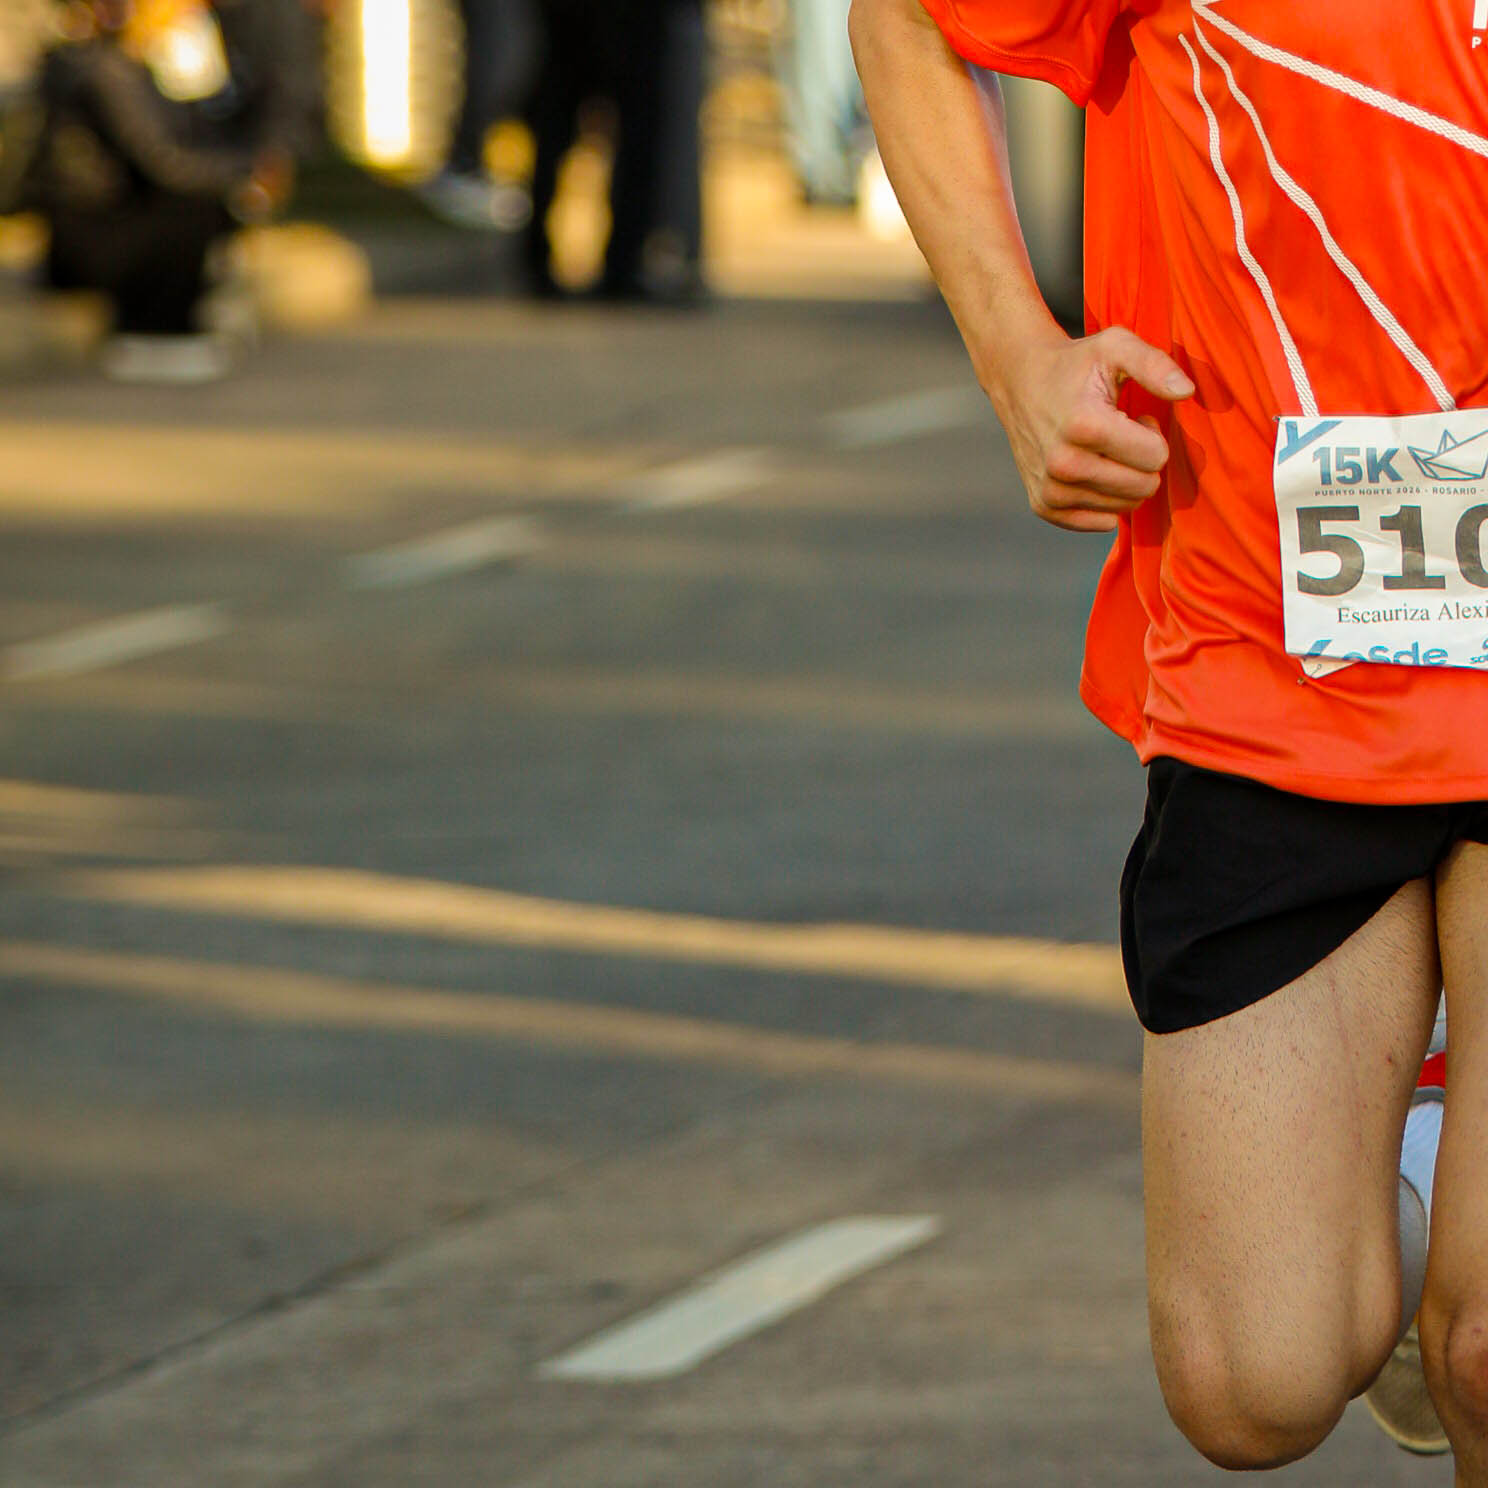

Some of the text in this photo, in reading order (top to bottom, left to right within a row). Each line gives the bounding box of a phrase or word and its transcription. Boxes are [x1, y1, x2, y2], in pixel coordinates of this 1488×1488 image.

[1312, 446, 1403, 486] 15K
[1315, 488, 1354, 496] PUERTO
[1359, 487, 1392, 495] NORTE
[1432, 487, 1477, 495] ROSARIO
[1337, 604, 1430, 624] Escauriza
